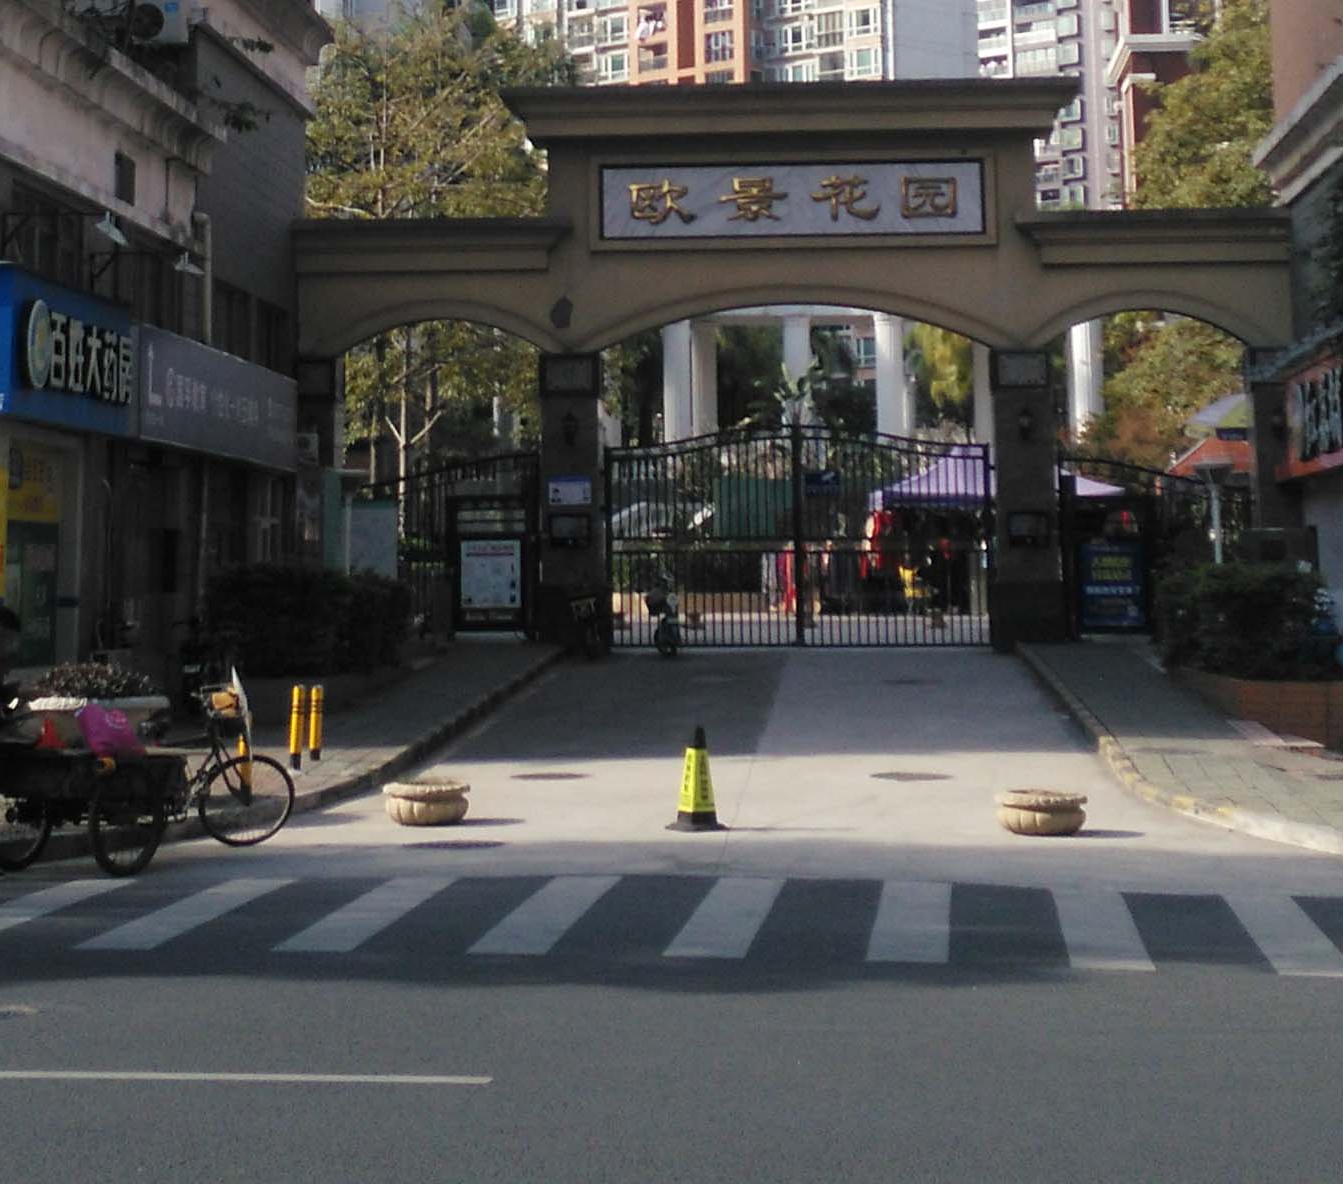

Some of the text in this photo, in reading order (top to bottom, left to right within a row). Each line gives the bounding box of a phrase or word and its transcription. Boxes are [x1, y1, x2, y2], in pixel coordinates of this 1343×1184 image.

[627, 174, 958, 224] 欧景花园
[49, 312, 131, 404] 百姓大药房
